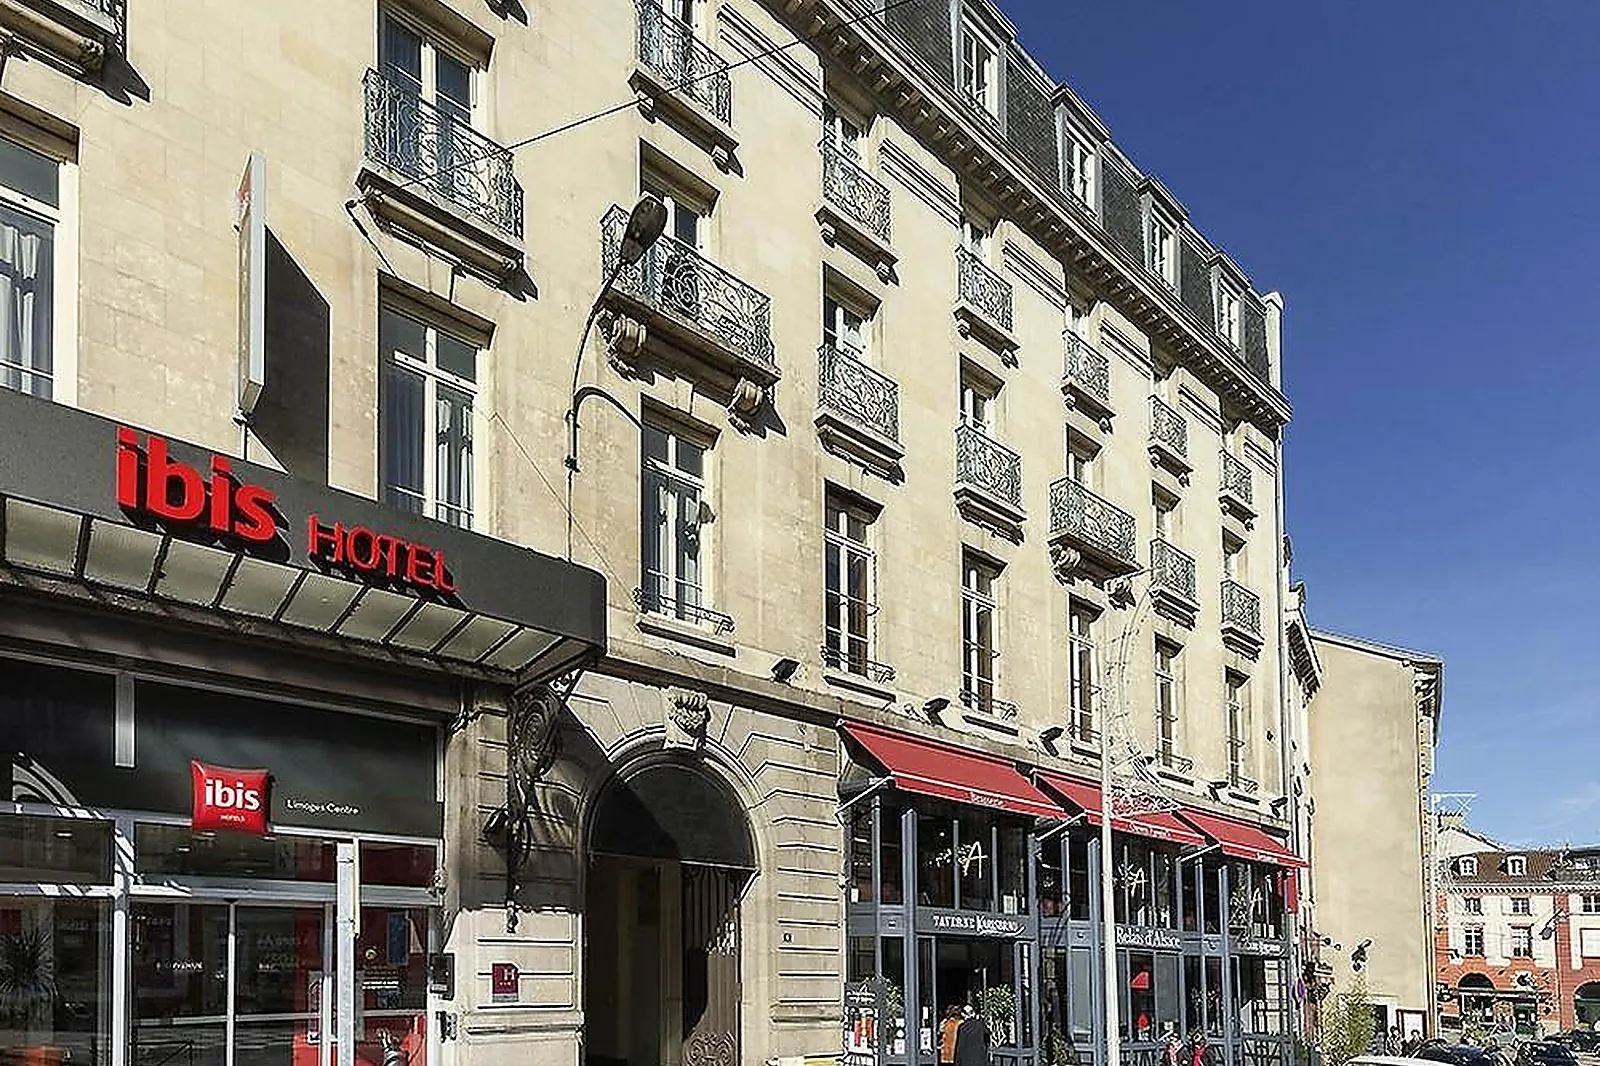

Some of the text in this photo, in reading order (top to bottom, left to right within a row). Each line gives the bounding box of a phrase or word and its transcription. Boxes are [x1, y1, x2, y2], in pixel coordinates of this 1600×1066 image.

[116, 426, 458, 595] ibis HOTEL
[205, 778, 260, 811] ibis
